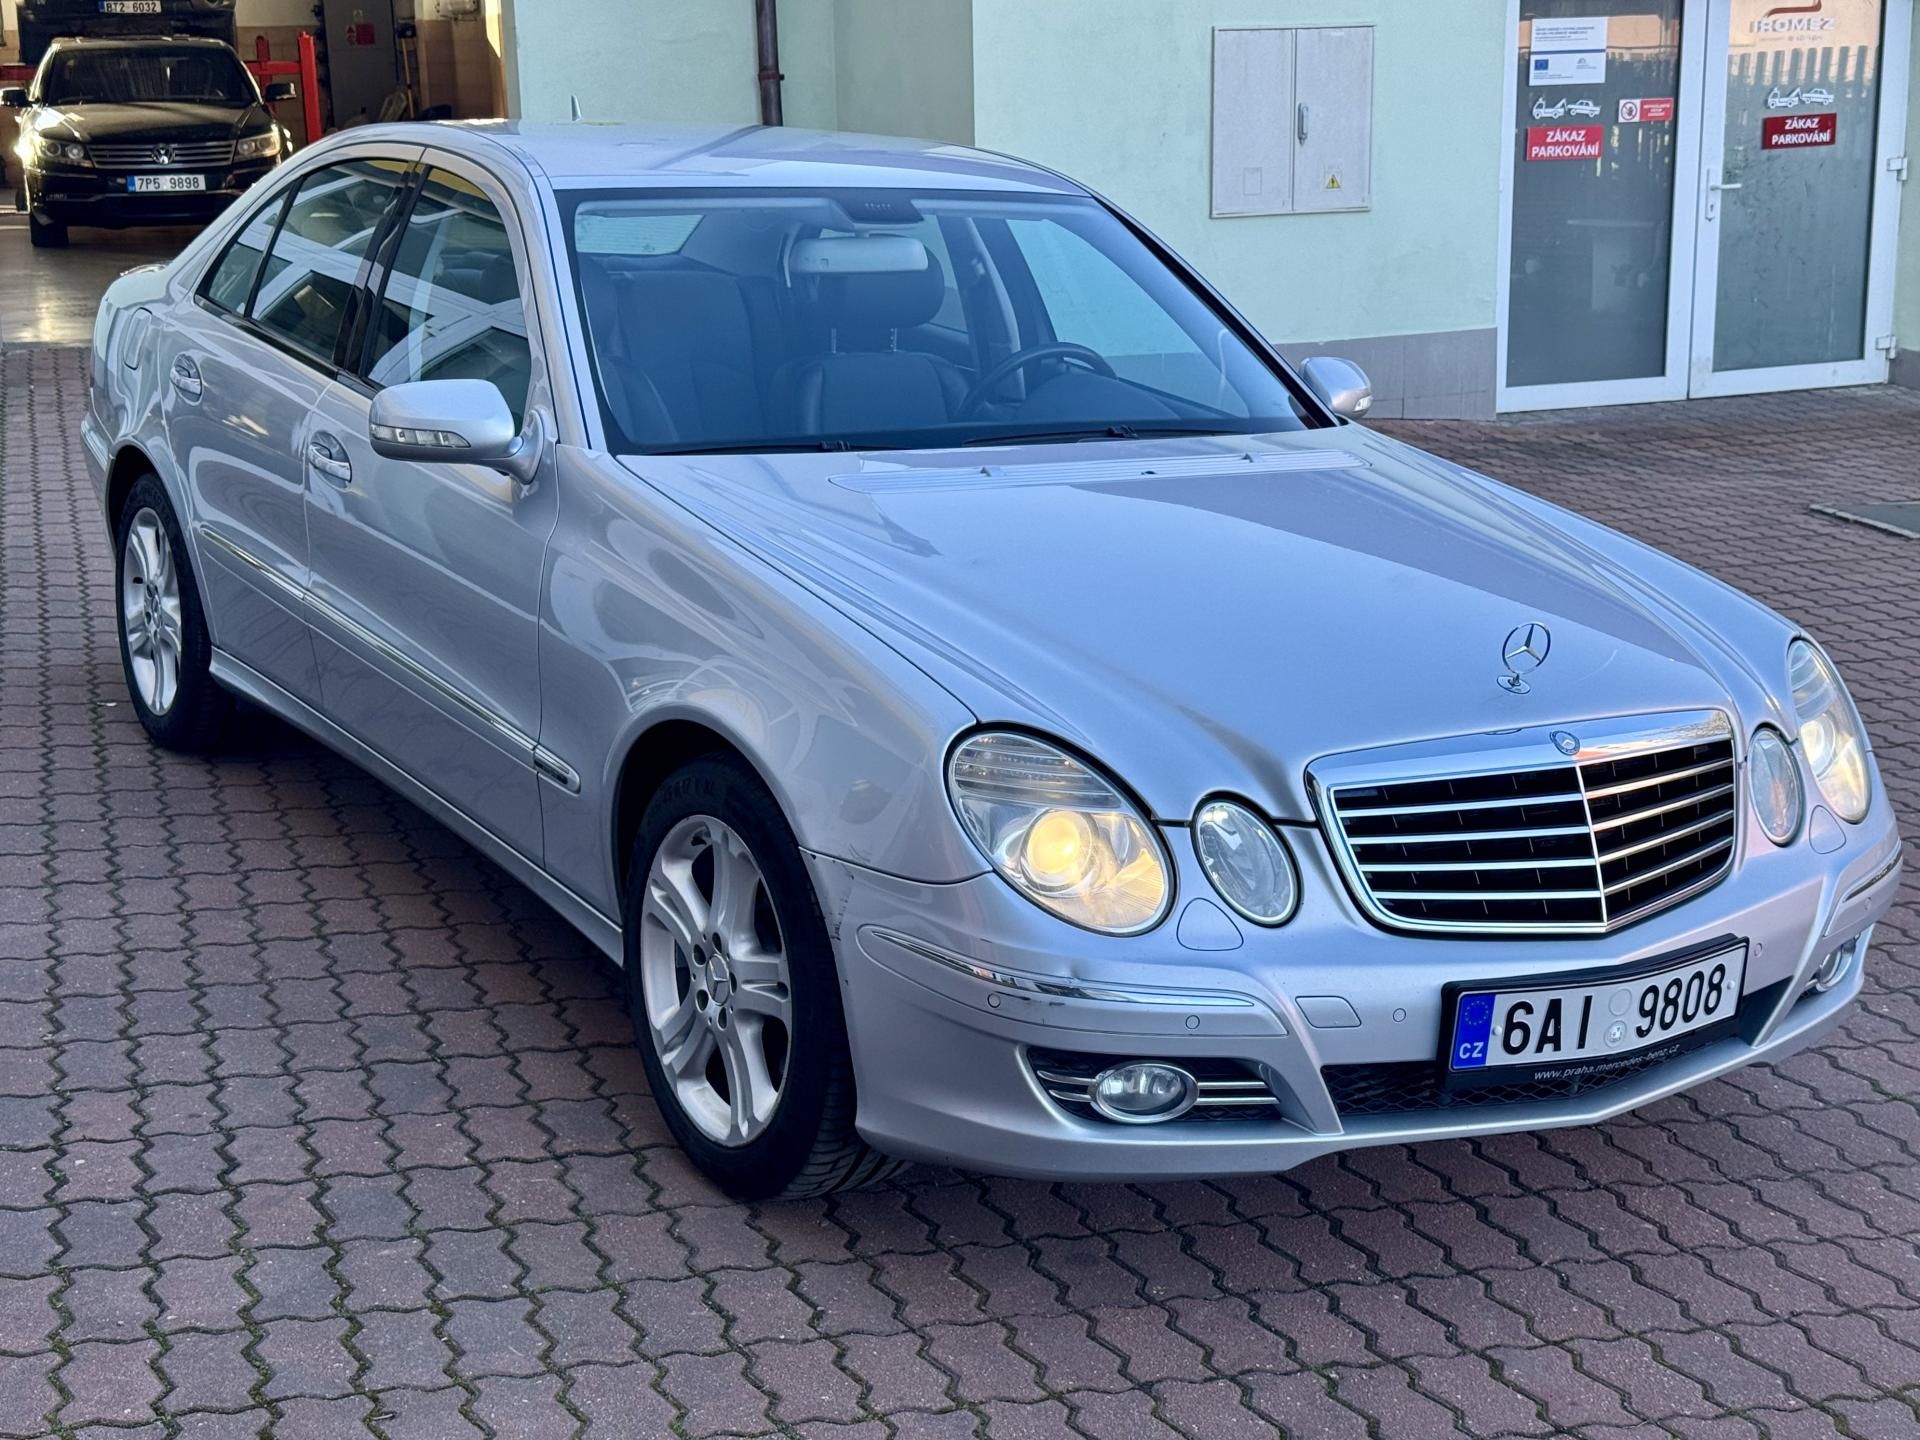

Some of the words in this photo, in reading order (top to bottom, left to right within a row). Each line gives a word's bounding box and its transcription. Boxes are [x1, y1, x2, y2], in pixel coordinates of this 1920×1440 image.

[132, 2, 157, 13] 6032
[1785, 117, 1820, 130] ZÁKAZ
[1546, 129, 1585, 142] ZÁKAZ
[1771, 129, 1832, 145] PARKOVÁNÍ
[1531, 142, 1600, 157] PARKOVÁNÍ
[138, 177, 161, 190] 7P5
[169, 176, 200, 189] 9898
[1636, 964, 1726, 1038] 9808
[1459, 1042, 1483, 1059] CZ
